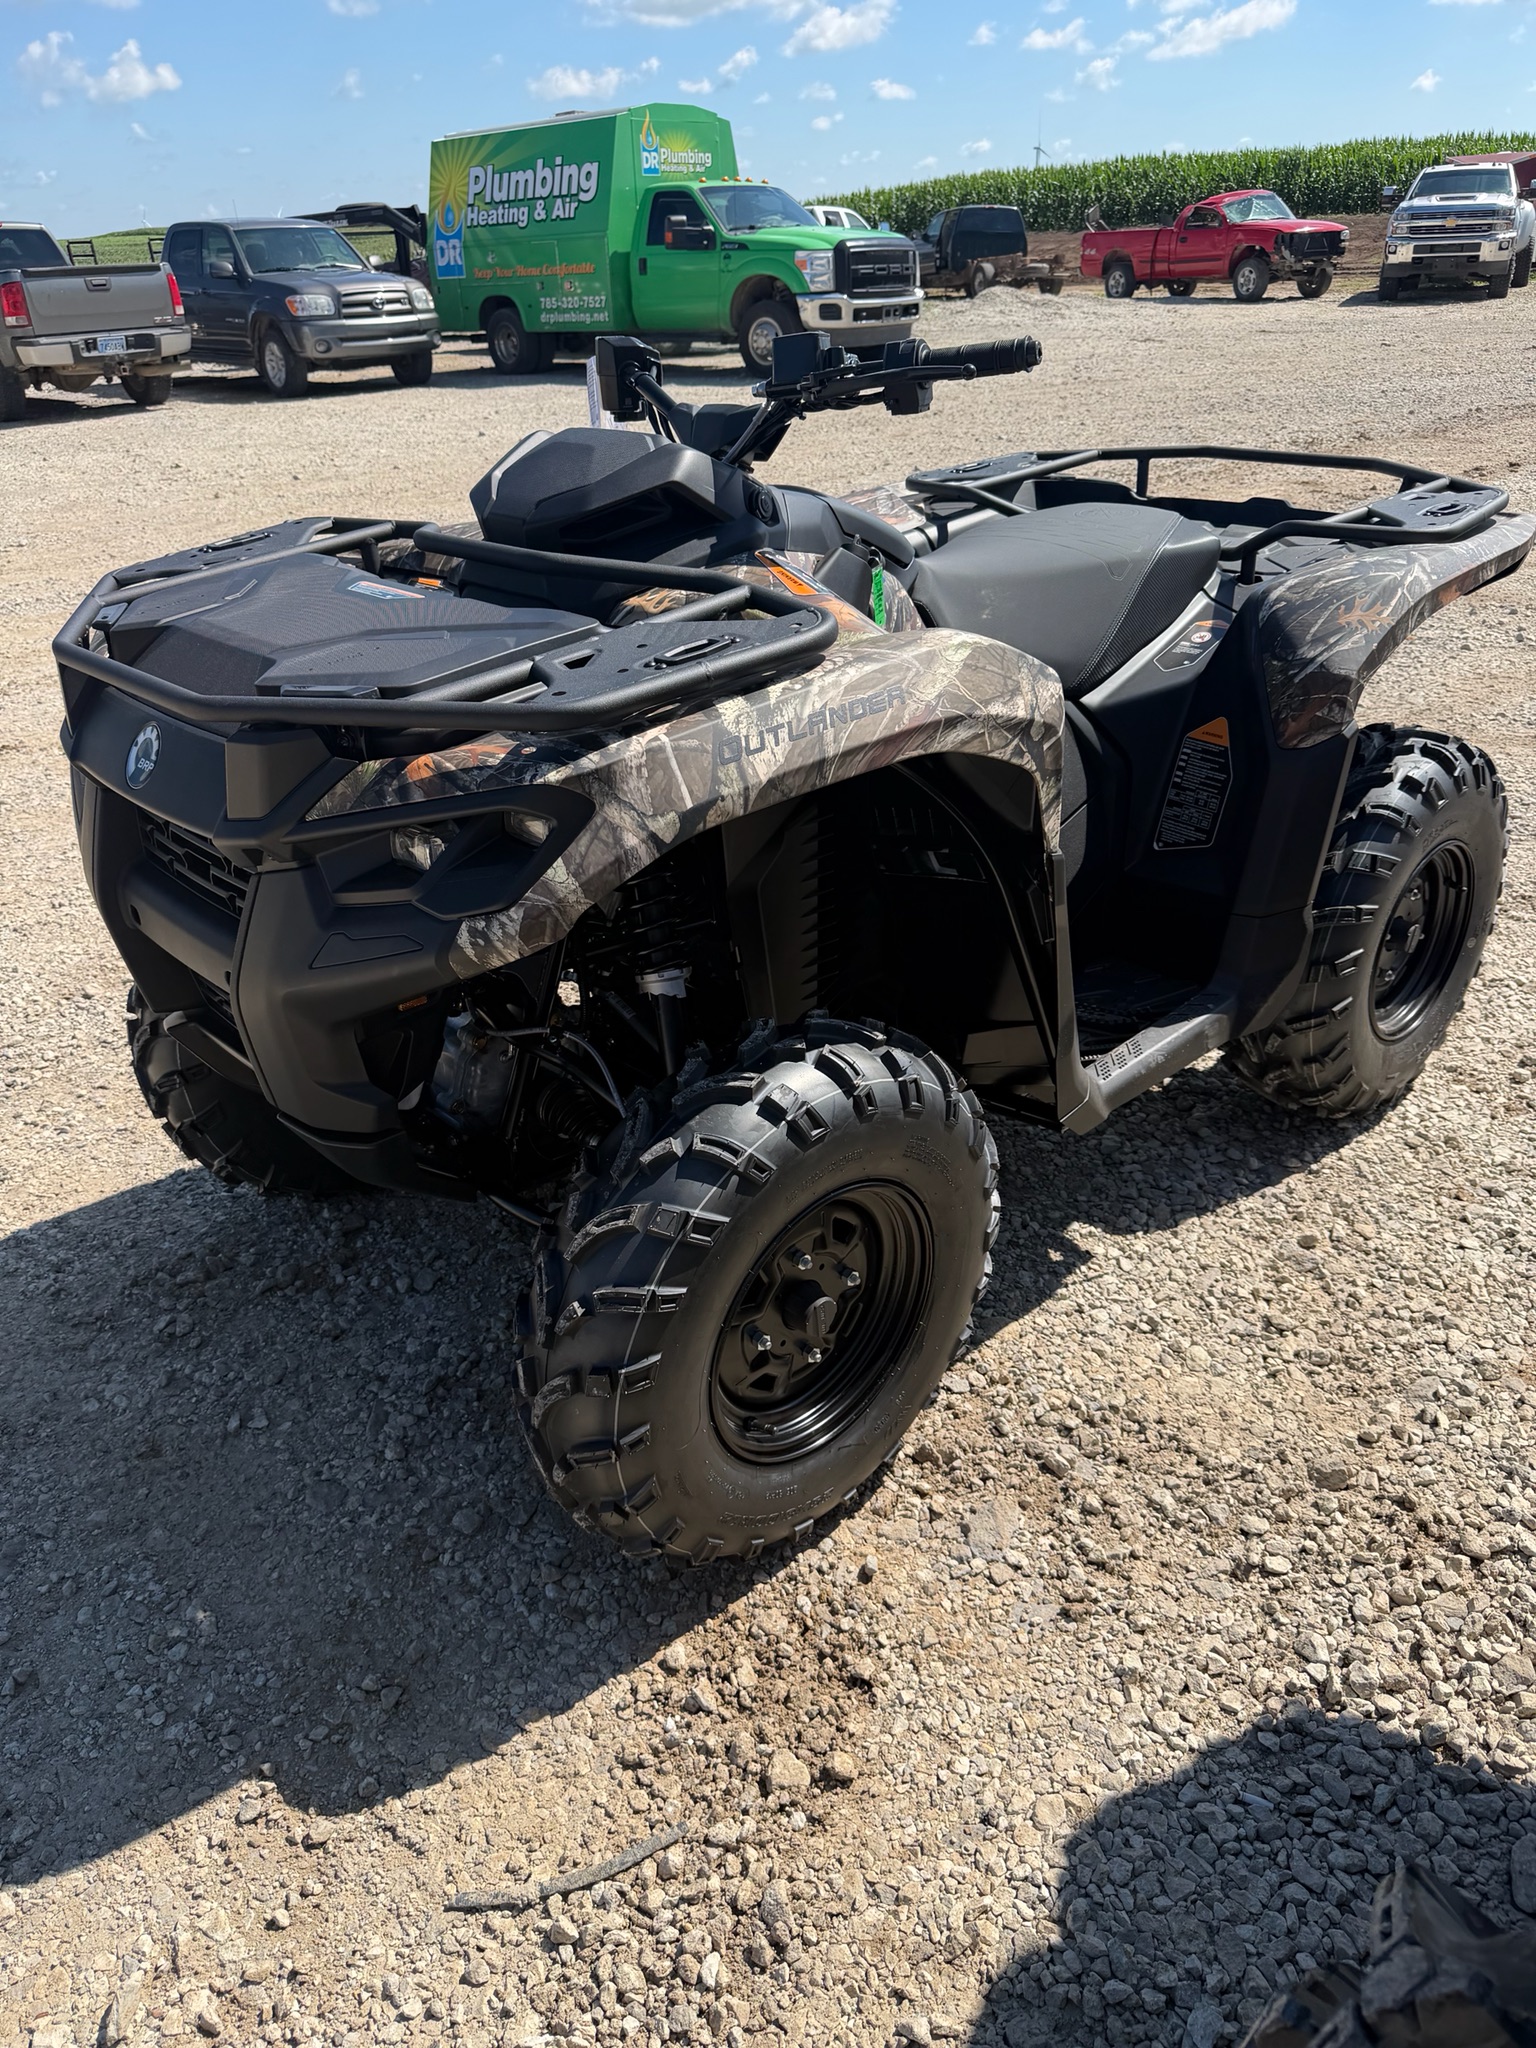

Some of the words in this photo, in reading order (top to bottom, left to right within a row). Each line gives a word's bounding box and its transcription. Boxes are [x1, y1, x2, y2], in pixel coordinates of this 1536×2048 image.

[642, 151, 659, 169] DR
[660, 148, 712, 167] Plumbing
[660, 165, 687, 174] Heating
[695, 164, 706, 172] Air
[467, 155, 599, 204] Plumbing
[466, 203, 529, 228] Heating
[534, 200, 547, 222] &
[551, 198, 579, 220] Air
[435, 239, 463, 267] DR
[515, 264, 541, 277] Home
[541, 262, 595, 277] Comfortable
[851, 264, 915, 275] FORD
[539, 295, 607, 309] 785-320-7527
[540, 312, 609, 325] drplumbing.net
[718, 684, 906, 766] OUTLANDER
[137, 757, 155, 772] BRP
